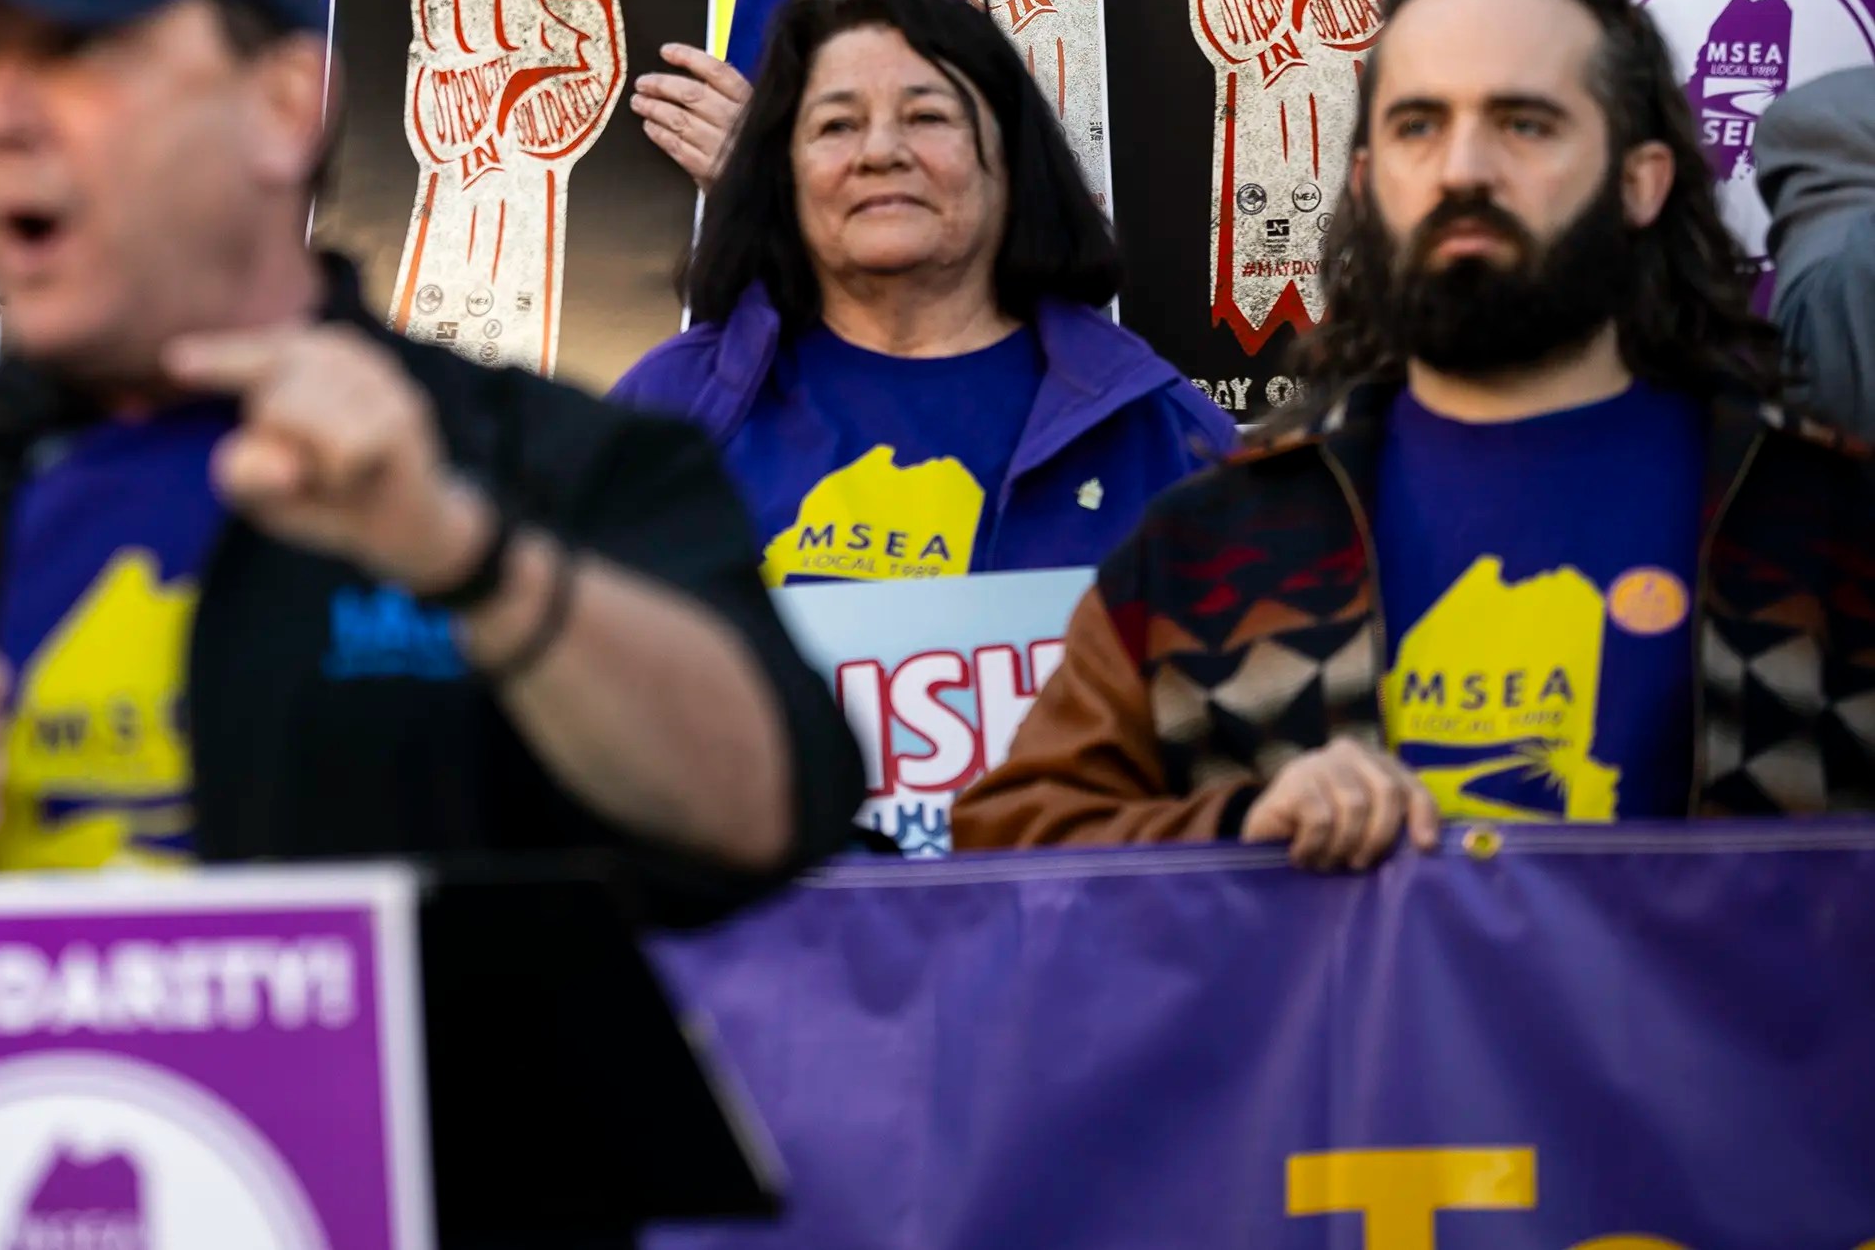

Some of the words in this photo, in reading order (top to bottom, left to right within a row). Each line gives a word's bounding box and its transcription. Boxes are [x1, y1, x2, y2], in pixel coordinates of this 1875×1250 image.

[1256, 30, 1303, 81] IN
[1706, 41, 1783, 64] MSEA
[432, 54, 511, 147] STRENGTH
[513, 74, 608, 148] SOLIDARITY
[1701, 119, 1756, 146] SEI
[461, 133, 501, 180] IN
[1241, 260, 1319, 278] #MAYDAY
[797, 523, 953, 562] MSEA
[1401, 666, 1576, 711] MSEA
[836, 638, 1065, 797] ISH
